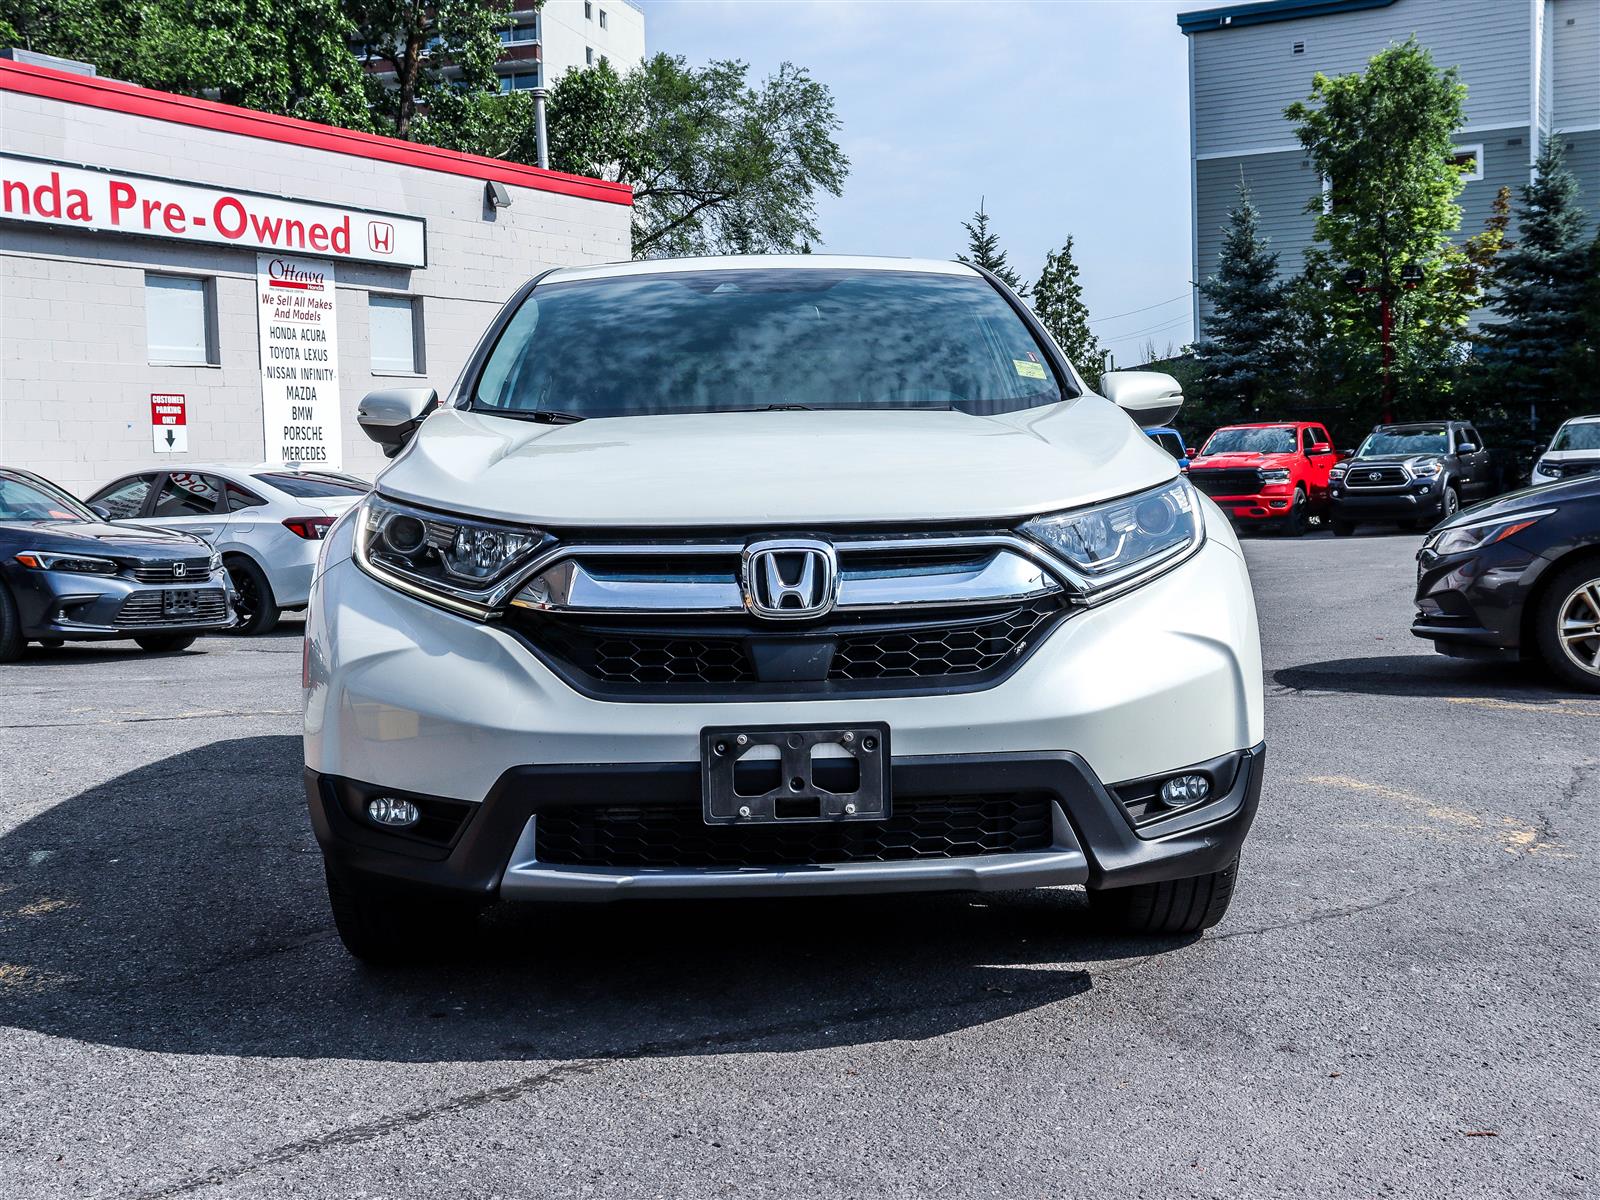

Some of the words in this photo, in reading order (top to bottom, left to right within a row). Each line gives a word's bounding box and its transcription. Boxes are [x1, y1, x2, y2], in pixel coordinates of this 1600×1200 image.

[109, 180, 350, 255] Pre-Owned
[268, 258, 324, 283] Ottawa
[262, 293, 275, 305] We
[276, 295, 293, 307] Sell
[294, 296, 306, 308] All
[307, 298, 333, 310] Makes
[274, 307, 291, 319] And
[292, 309, 321, 322] Models
[269, 326, 298, 341] HONDA
[300, 328, 327, 342] ACURA
[269, 346, 301, 361] TOYOTA
[303, 348, 329, 362] LEXUS
[266, 366, 297, 380] NISSAN
[300, 367, 334, 382] INFINITY
[286, 385, 318, 401] MAZDA
[162, 416, 177, 425] ONLY
[292, 406, 313, 421] BMW
[283, 426, 324, 441] PORSCHE
[282, 446, 327, 461] MERCEDES
